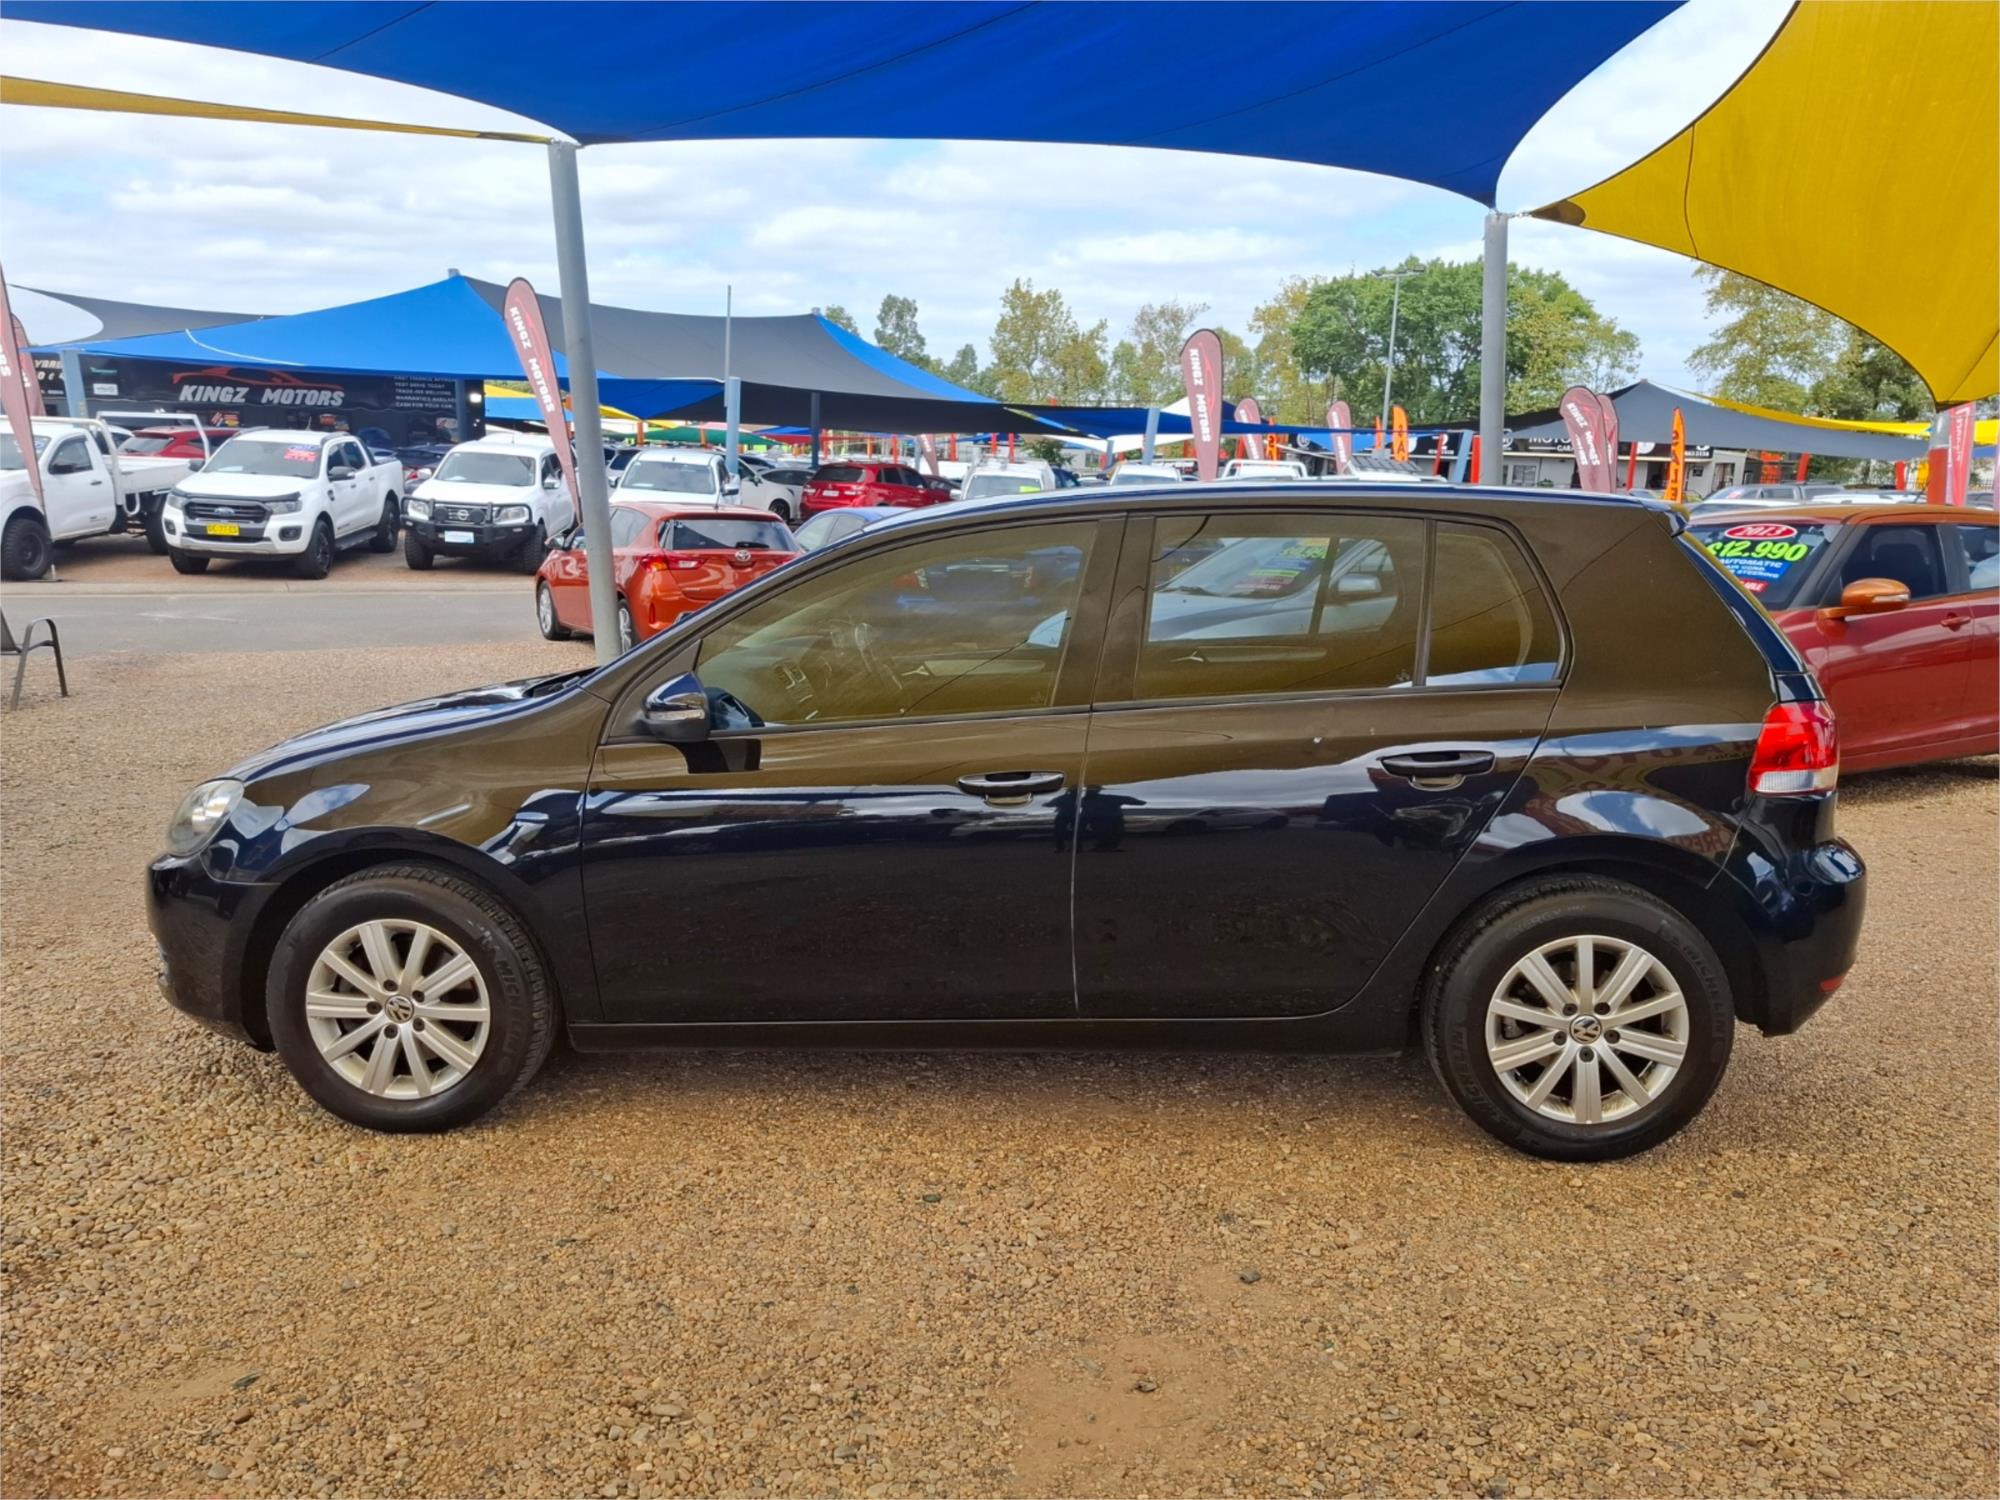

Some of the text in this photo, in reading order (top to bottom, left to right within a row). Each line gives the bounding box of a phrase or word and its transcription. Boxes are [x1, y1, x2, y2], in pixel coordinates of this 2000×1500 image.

[509, 306, 556, 413] KINGZ MOTORS
[178, 384, 345, 407] KINGZ MOTORS
[1189, 348, 1211, 442] KINGZ MOTORS
[1733, 526, 1788, 538] 2013
[1719, 558, 1783, 569] AUTOMATIC
